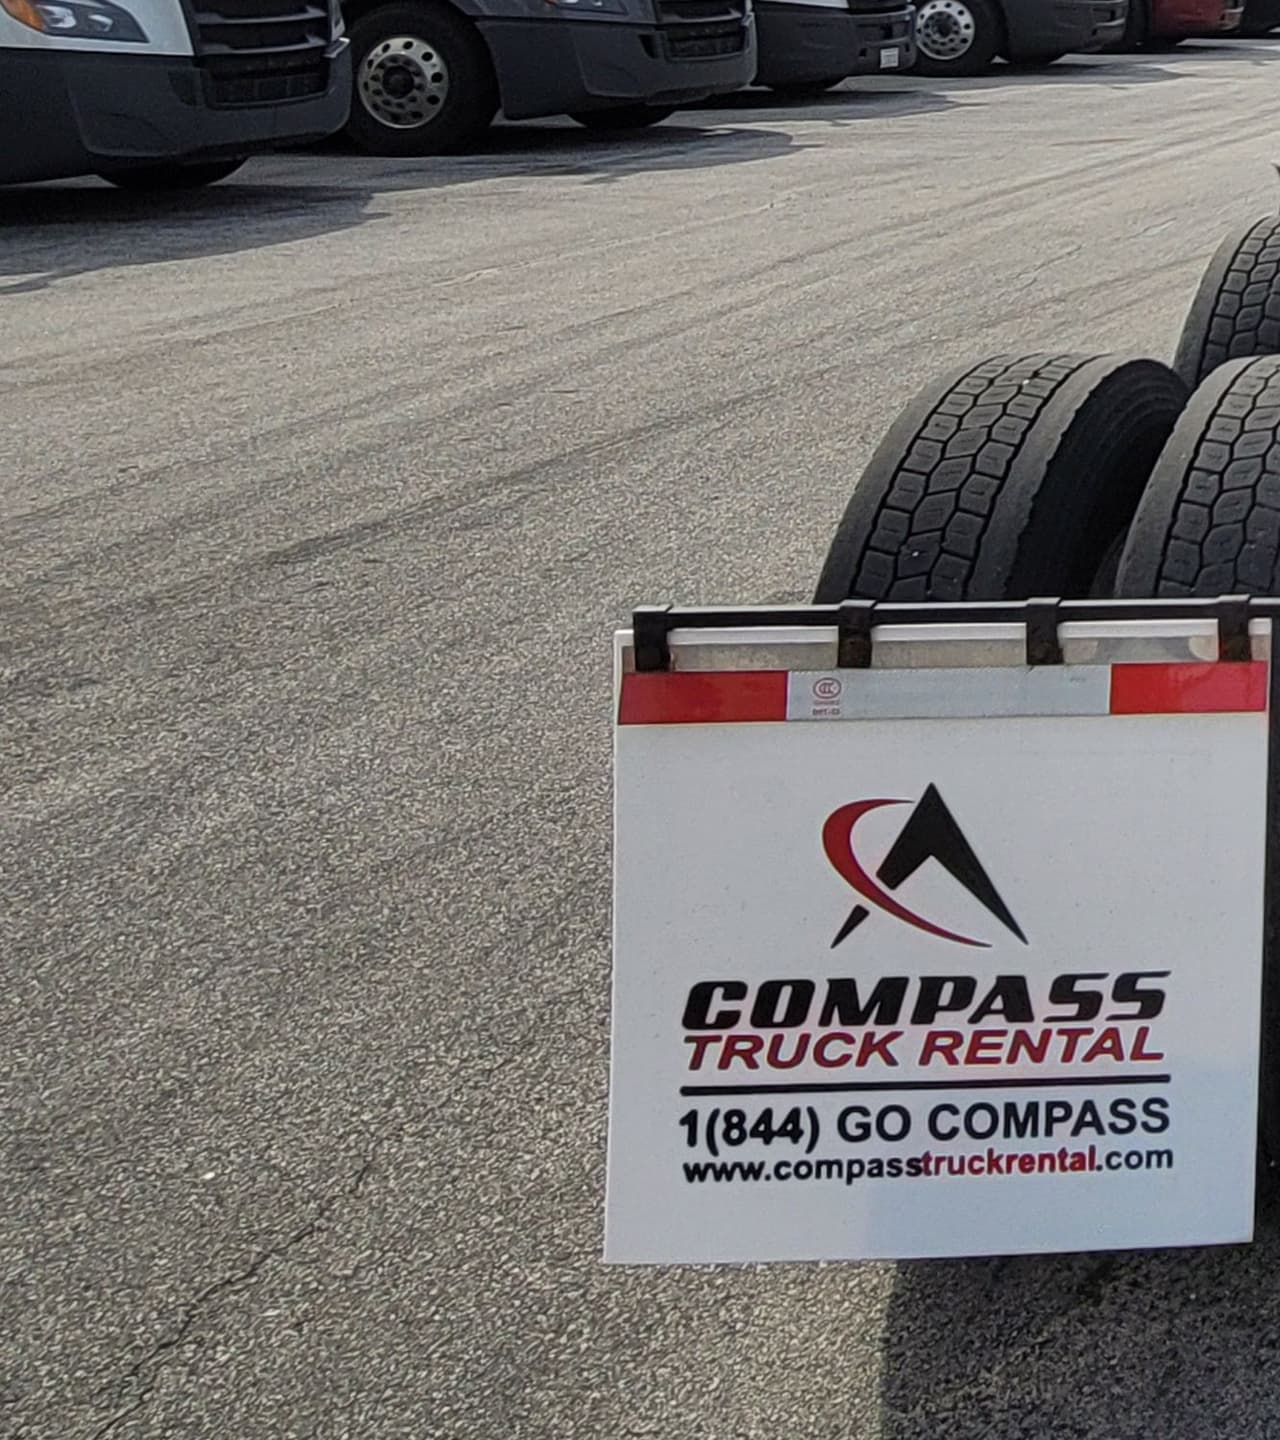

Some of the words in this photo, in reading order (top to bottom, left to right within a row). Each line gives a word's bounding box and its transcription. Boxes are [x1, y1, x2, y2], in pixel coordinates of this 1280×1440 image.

[681, 970, 1171, 1031] COMPASS
[683, 1030, 905, 1071] TRUCK
[918, 1026, 1164, 1067] RENTAL
[678, 1106, 820, 1158] 1(844)
[836, 1104, 912, 1143] GO
[927, 1096, 1170, 1142] COMPASS
[682, 1144, 1174, 1186] www.compasstruckrental.com
